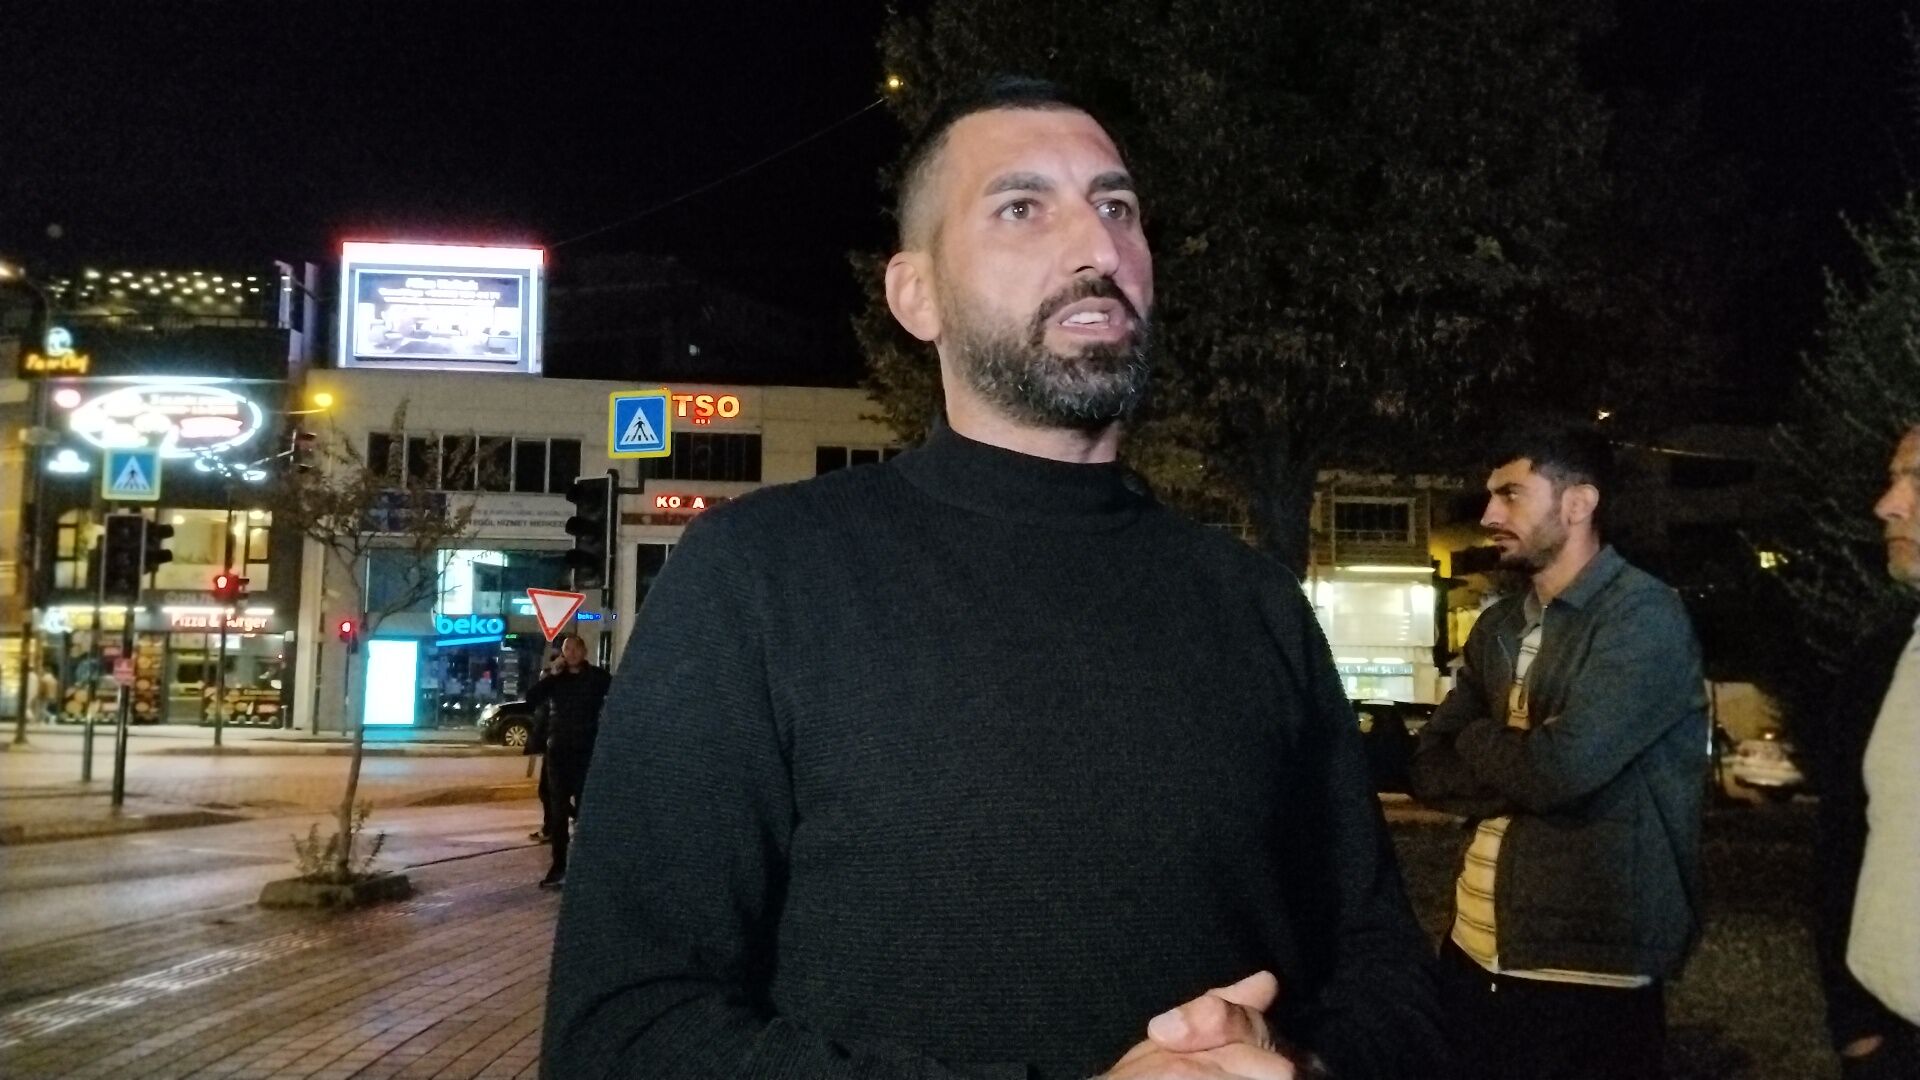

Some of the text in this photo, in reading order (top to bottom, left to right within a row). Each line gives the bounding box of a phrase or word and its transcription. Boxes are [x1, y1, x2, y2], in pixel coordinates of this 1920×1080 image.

[663, 387, 740, 418] TSO
[171, 612, 207, 628] Pizza
[436, 614, 504, 635] beko
